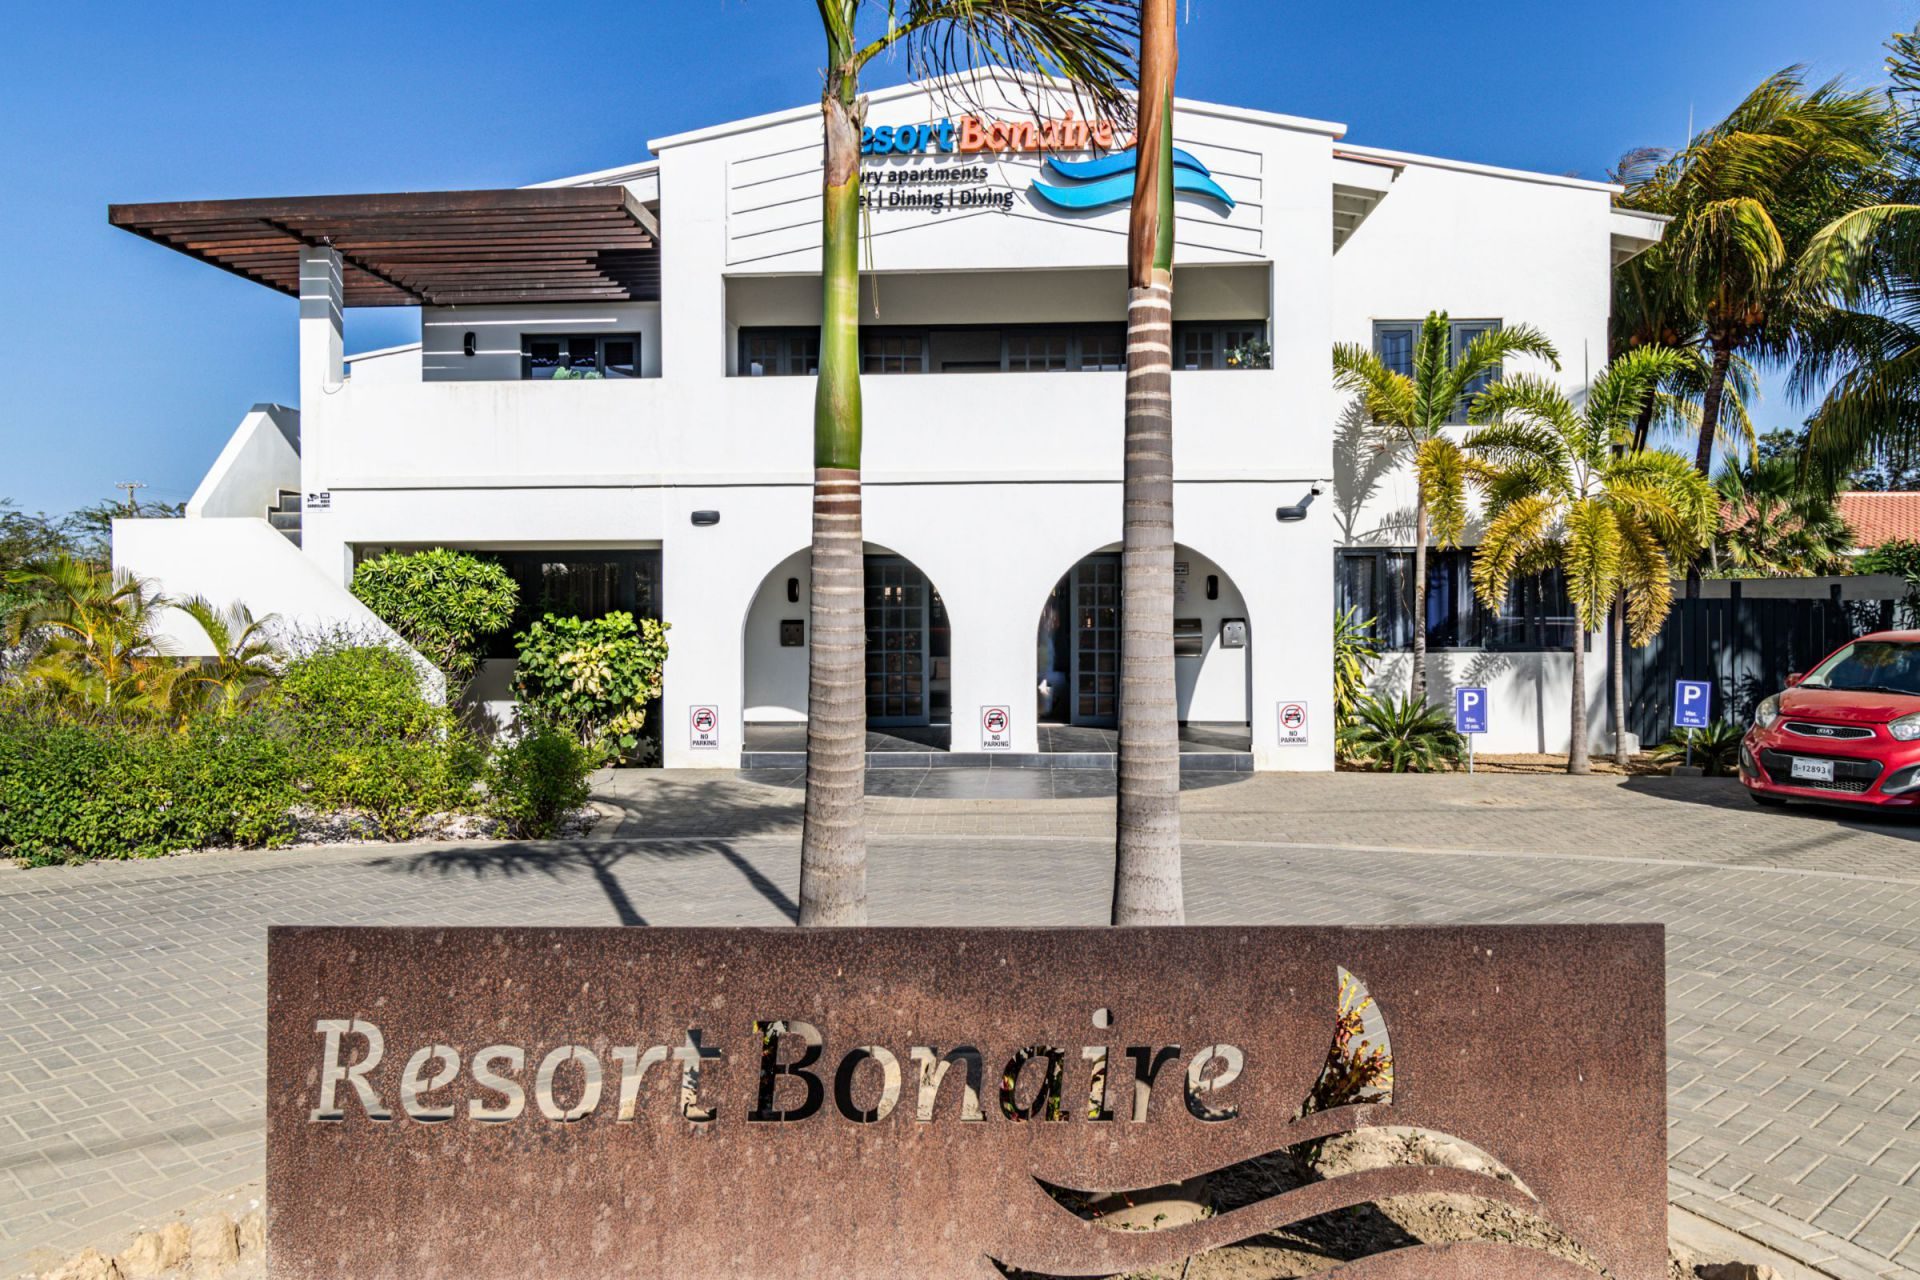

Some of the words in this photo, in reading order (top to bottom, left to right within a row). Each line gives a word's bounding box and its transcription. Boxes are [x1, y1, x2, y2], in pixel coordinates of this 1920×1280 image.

[861, 117, 953, 154] esort
[960, 110, 1115, 152] Bonaire
[887, 166, 988, 184] apartments
[889, 190, 943, 208] Dining
[960, 188, 1014, 207] Diving
[1463, 691, 1479, 711] P
[1683, 685, 1701, 705] P
[1793, 763, 1826, 774] B-12893
[308, 1018, 722, 1123] Resort
[747, 1007, 1245, 1124] Bonaire
